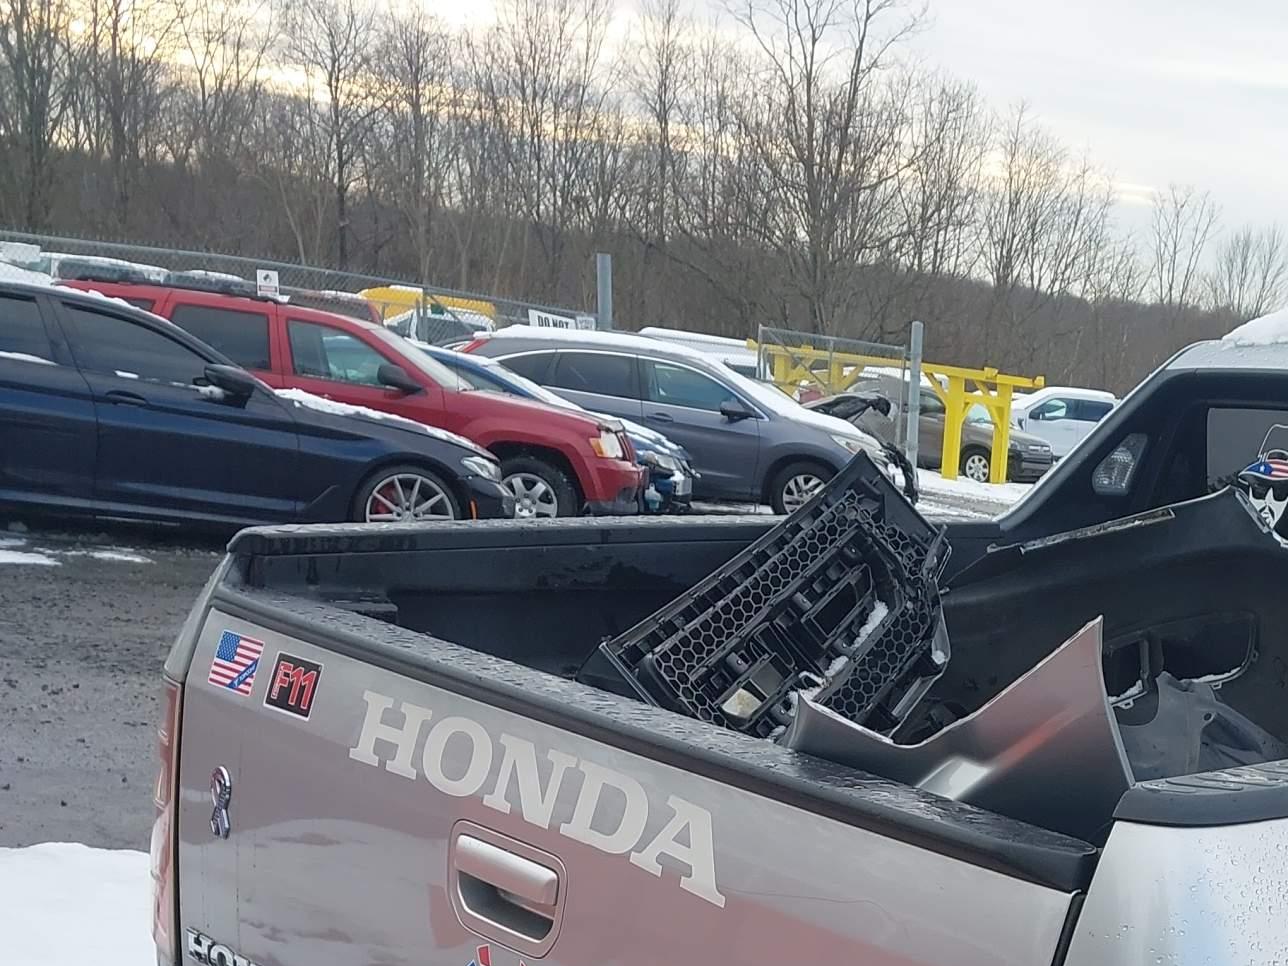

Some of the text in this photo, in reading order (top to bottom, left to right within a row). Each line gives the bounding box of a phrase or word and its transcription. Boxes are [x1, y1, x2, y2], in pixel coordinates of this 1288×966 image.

[537, 315, 550, 328] DO
[552, 318, 569, 329] NOT
[348, 689, 726, 908] HONDA
